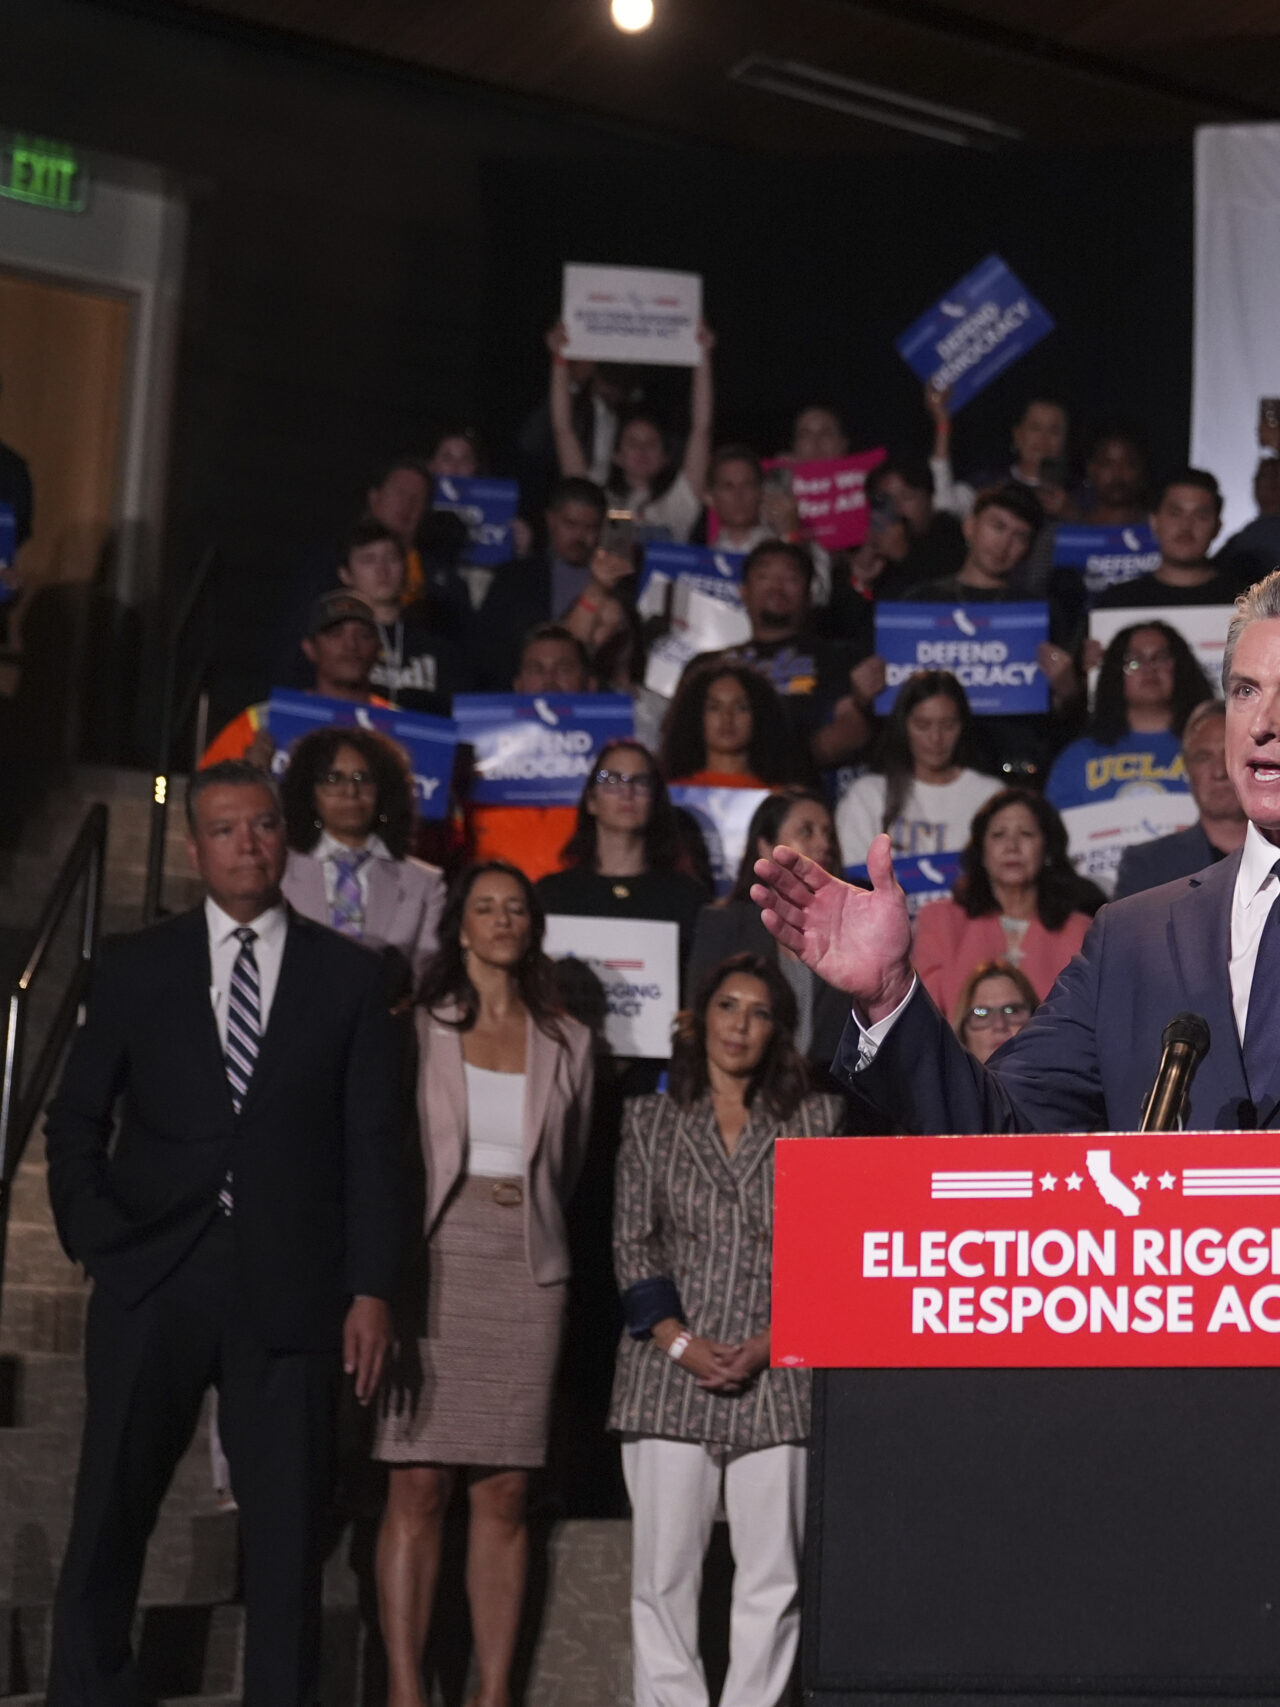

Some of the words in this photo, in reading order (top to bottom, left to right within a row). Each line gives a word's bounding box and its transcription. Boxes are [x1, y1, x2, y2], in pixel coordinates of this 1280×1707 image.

[12, 150, 78, 205] EXIT
[886, 661, 1040, 687] DECRACY
[916, 640, 1009, 664] DEFEND
[862, 1229, 1117, 1278] ELECTION
[911, 1285, 1194, 1334] RESPONSE
